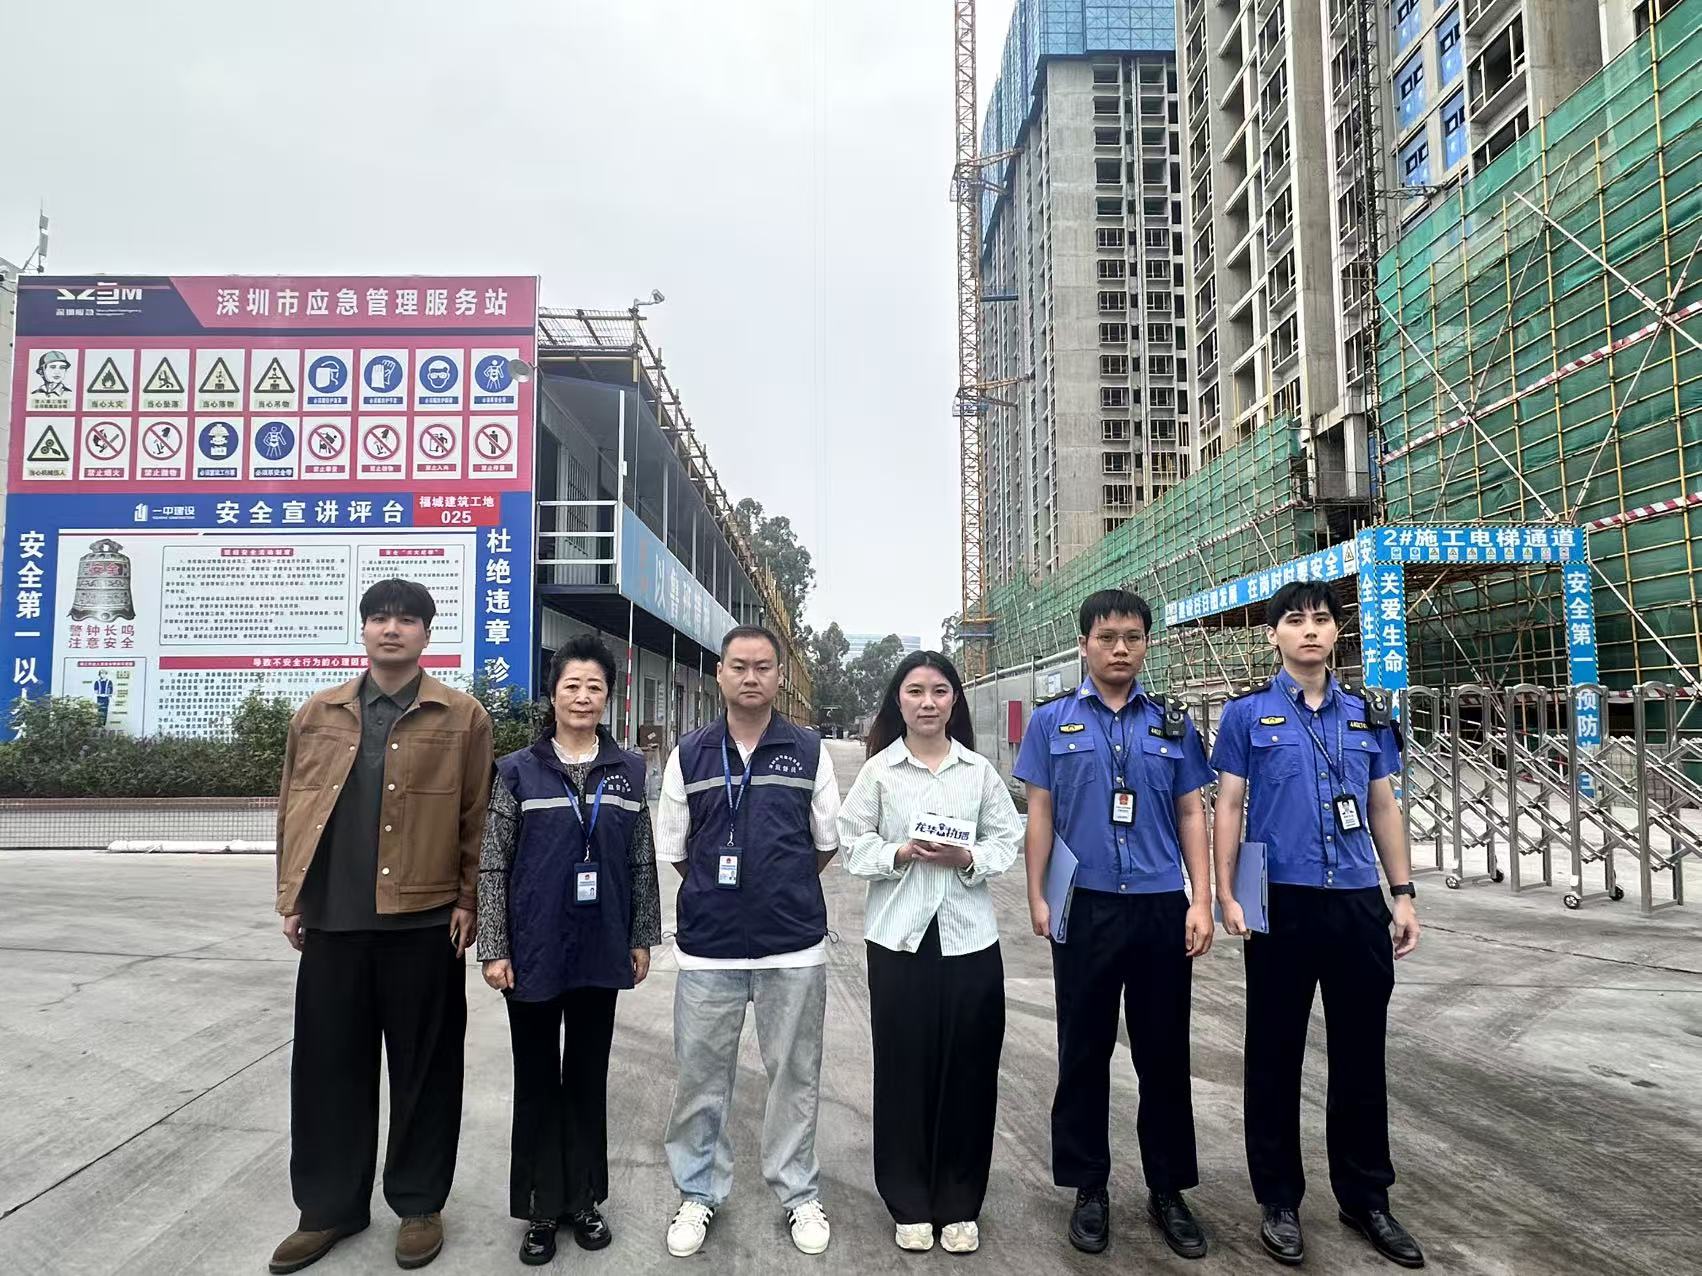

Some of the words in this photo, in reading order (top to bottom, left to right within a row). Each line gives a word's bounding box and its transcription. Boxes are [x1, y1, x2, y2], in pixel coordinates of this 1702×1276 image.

[216, 288, 509, 317] 深圳市应急管理服务站
[91, 401, 124, 409] 当心火灾
[152, 506, 195, 516] 一中建设
[216, 500, 405, 524] 安全宣讲评台
[419, 495, 495, 509] 福城建筑工地
[440, 511, 472, 524] 025
[1383, 529, 1576, 548] 2#施工电梯通道
[14, 531, 45, 638] 安全第一
[485, 528, 513, 645] 杜绝违章
[1359, 535, 1377, 678] 安全生产
[1567, 571, 1594, 662] 安全第一
[69, 624, 135, 637] 警钟长鸣
[1380, 572, 1404, 673] 关爱生命
[69, 637, 134, 649] 注意安全
